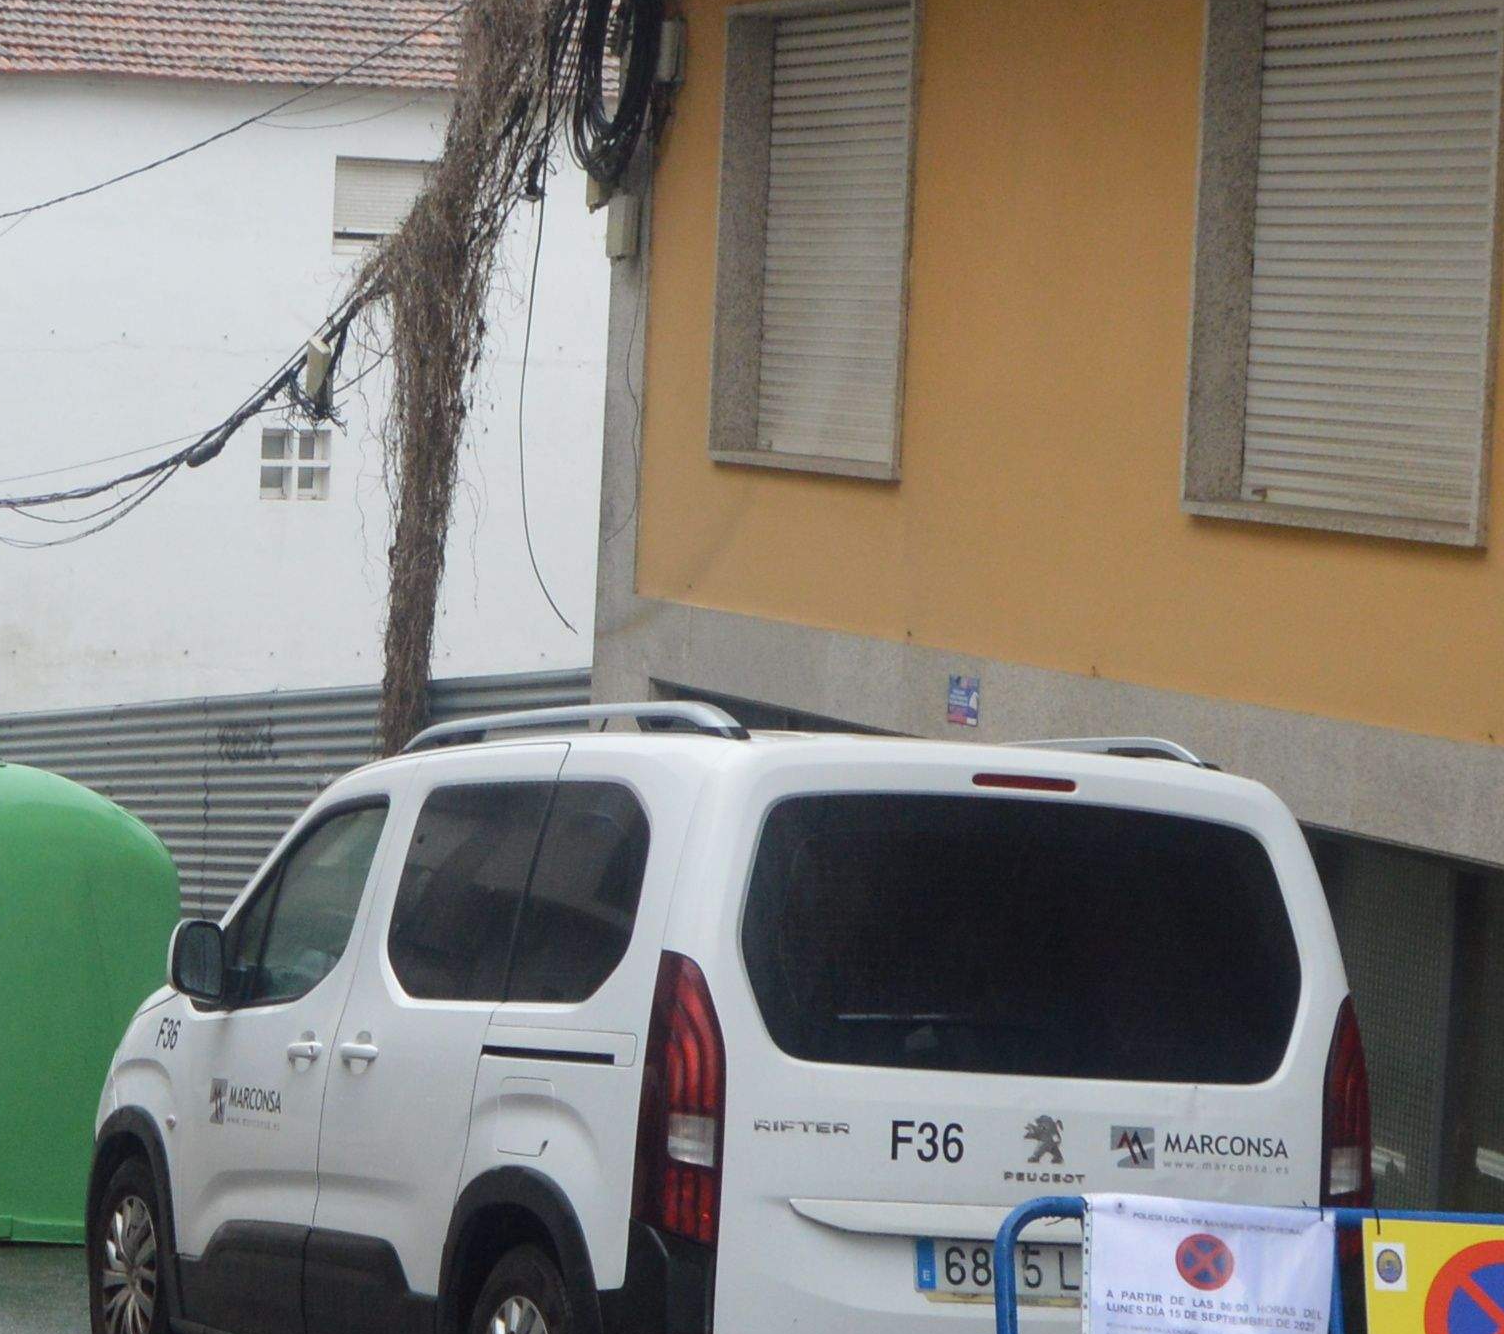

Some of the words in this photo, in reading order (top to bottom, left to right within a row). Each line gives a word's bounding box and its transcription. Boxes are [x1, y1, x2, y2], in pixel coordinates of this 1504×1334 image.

[155, 1017, 182, 1051] F36
[228, 1086, 282, 1114] MARCONSA
[753, 1119, 850, 1135] RIFTER
[891, 1120, 965, 1163] F36
[1163, 1132, 1289, 1159] MARCONSA
[1003, 1171, 1086, 1185] PEUGEOT
[1162, 1159, 1290, 1175] www.marconsa.es
[944, 1246, 1042, 1289] 685
[1106, 1303, 1144, 1316] LUNES
[1169, 1309, 1181, 1319] 15
[1184, 1310, 1197, 1321] DE
[1276, 1318, 1291, 1329] DE
[1120, 1291, 1163, 1304] PARTIR
[1170, 1295, 1185, 1306] DE
[1192, 1298, 1214, 1310] LAS
[1256, 1304, 1296, 1317] HORAS
